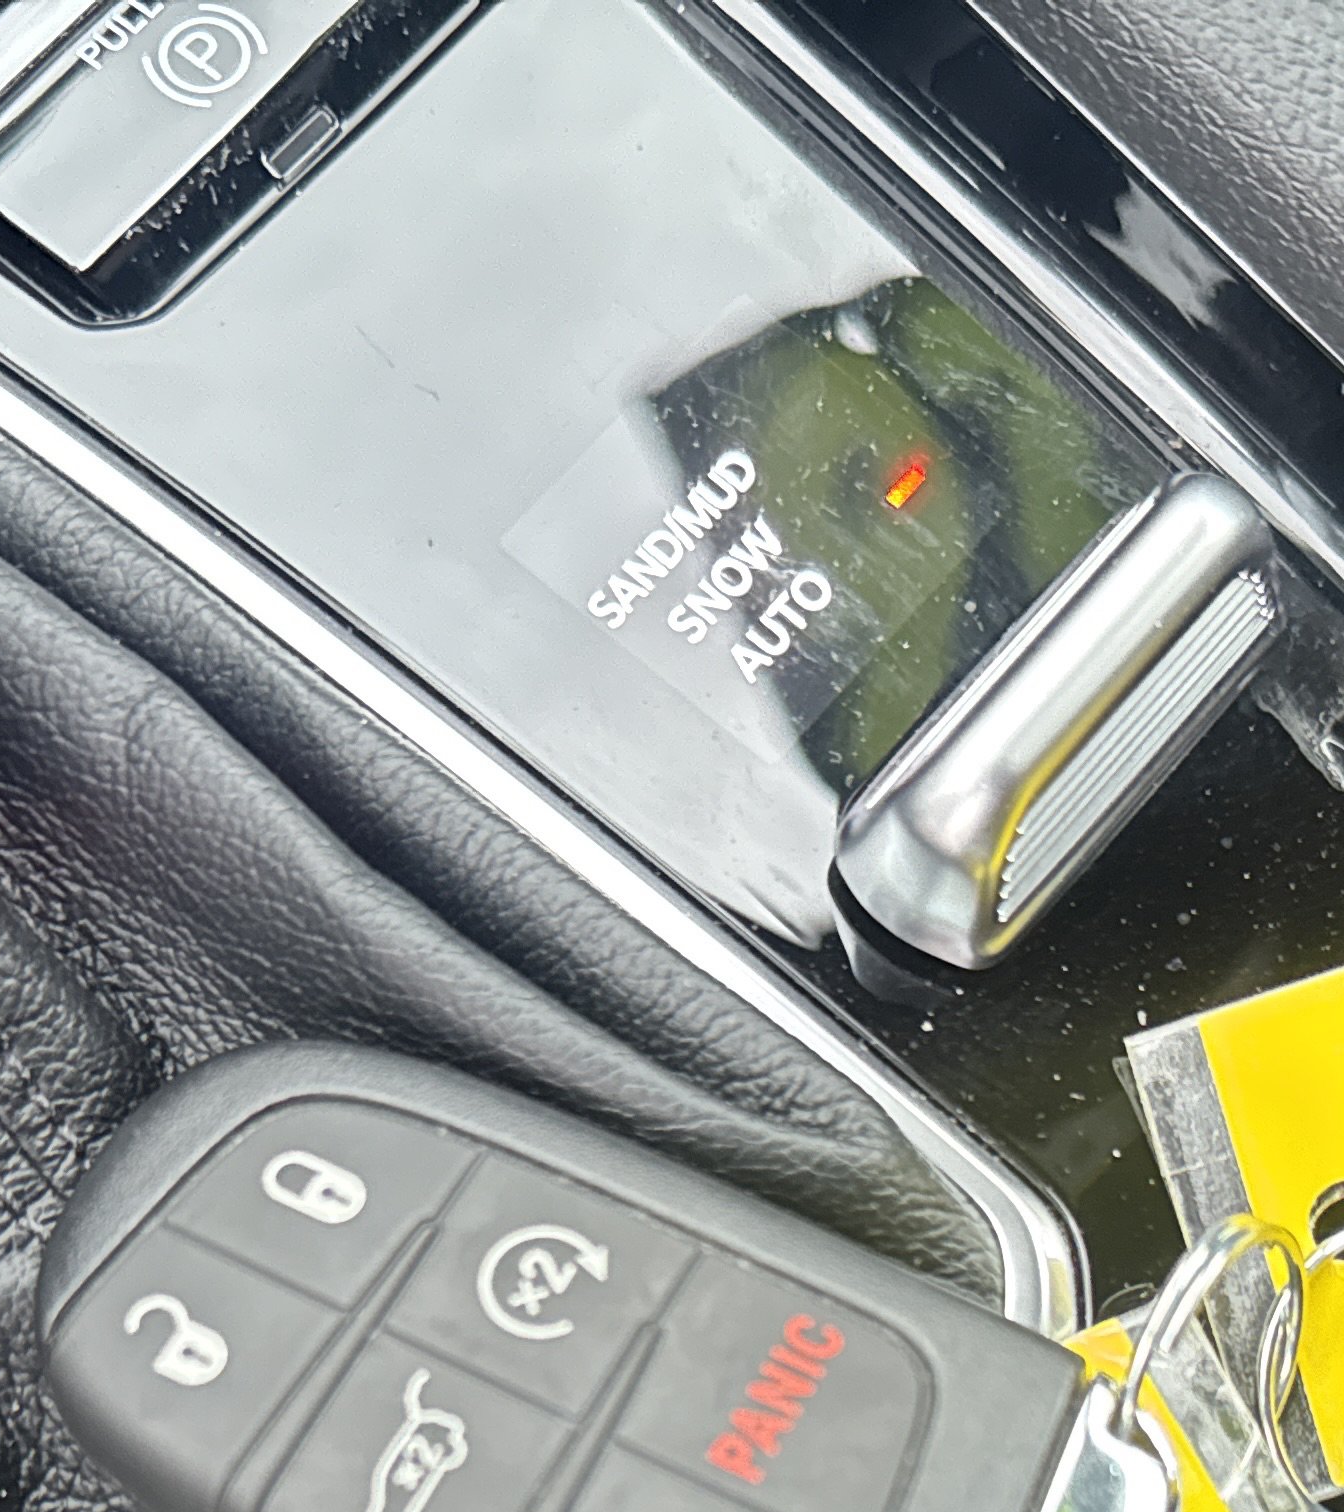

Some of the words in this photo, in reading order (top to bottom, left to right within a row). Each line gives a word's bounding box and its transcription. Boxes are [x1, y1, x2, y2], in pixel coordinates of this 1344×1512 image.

[76, 0, 164, 71] PULL
[587, 450, 756, 630] SAND/MUD
[667, 512, 783, 644] SNOW
[730, 570, 832, 684] AUTO
[705, 1312, 846, 1485] PANIC
